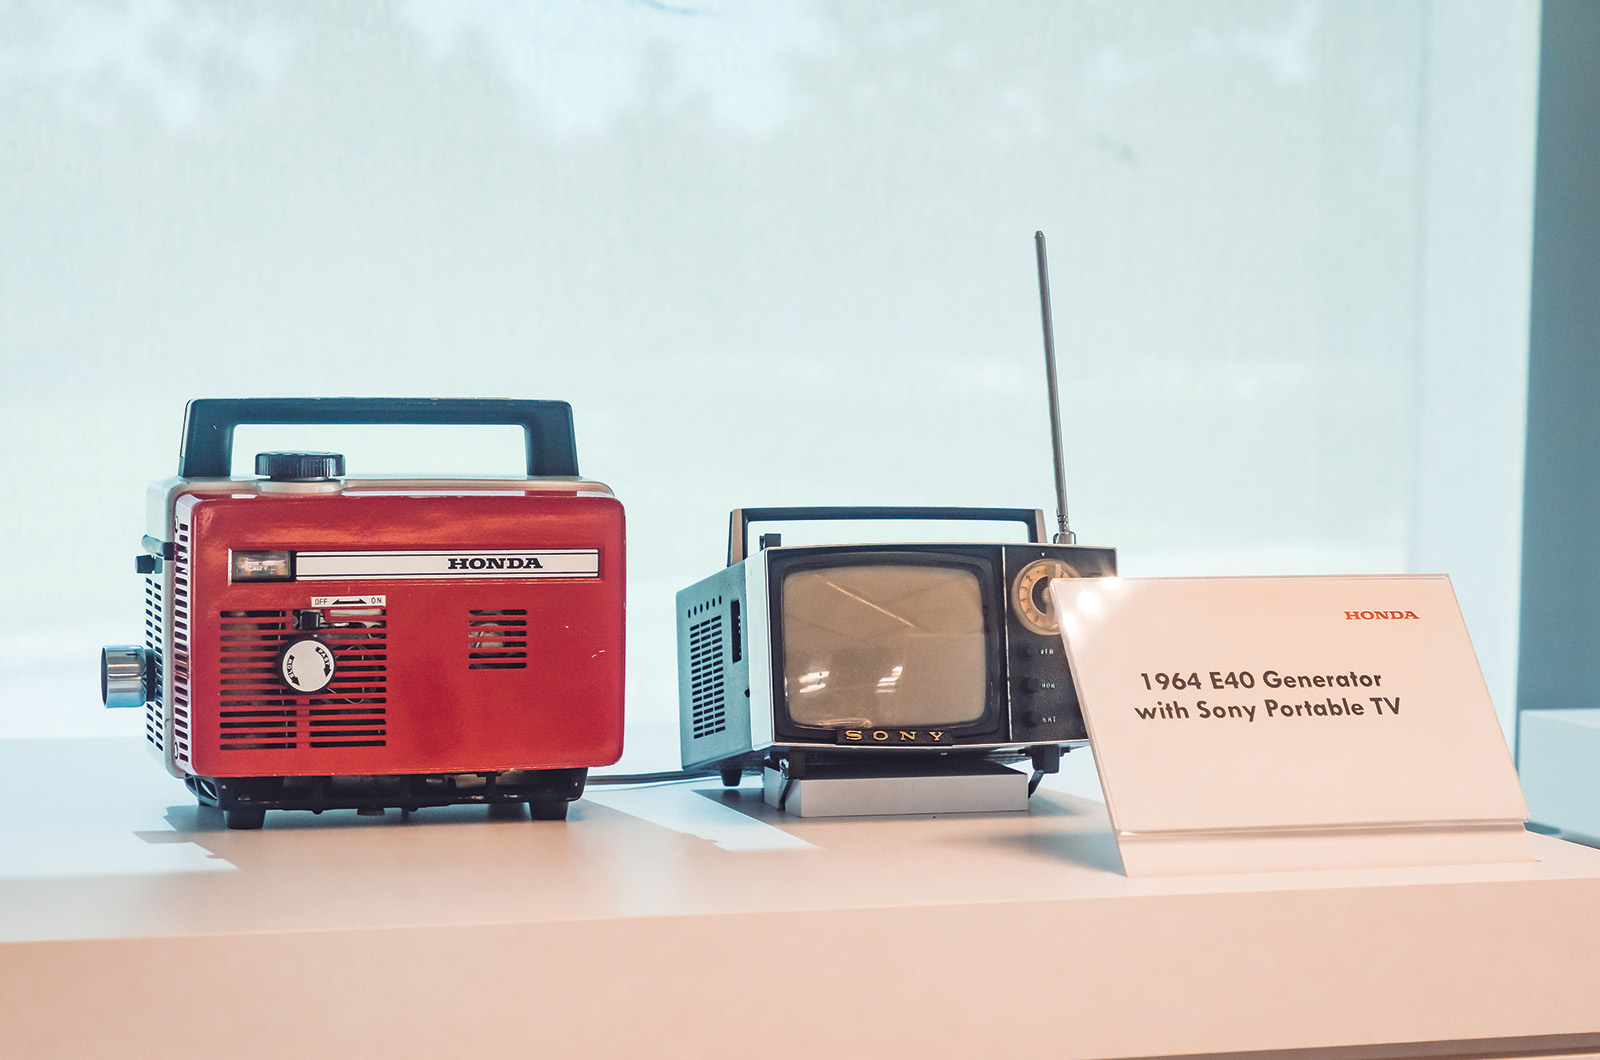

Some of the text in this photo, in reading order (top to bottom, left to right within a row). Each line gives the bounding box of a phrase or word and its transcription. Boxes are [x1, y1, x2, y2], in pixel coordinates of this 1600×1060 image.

[448, 557, 543, 570] HONDA
[1344, 610, 1420, 620] HONDA
[1141, 670, 1382, 690] 1964 E40 Generator
[1134, 696, 1400, 722] with Sony Portable TV
[845, 730, 944, 741] SONY
